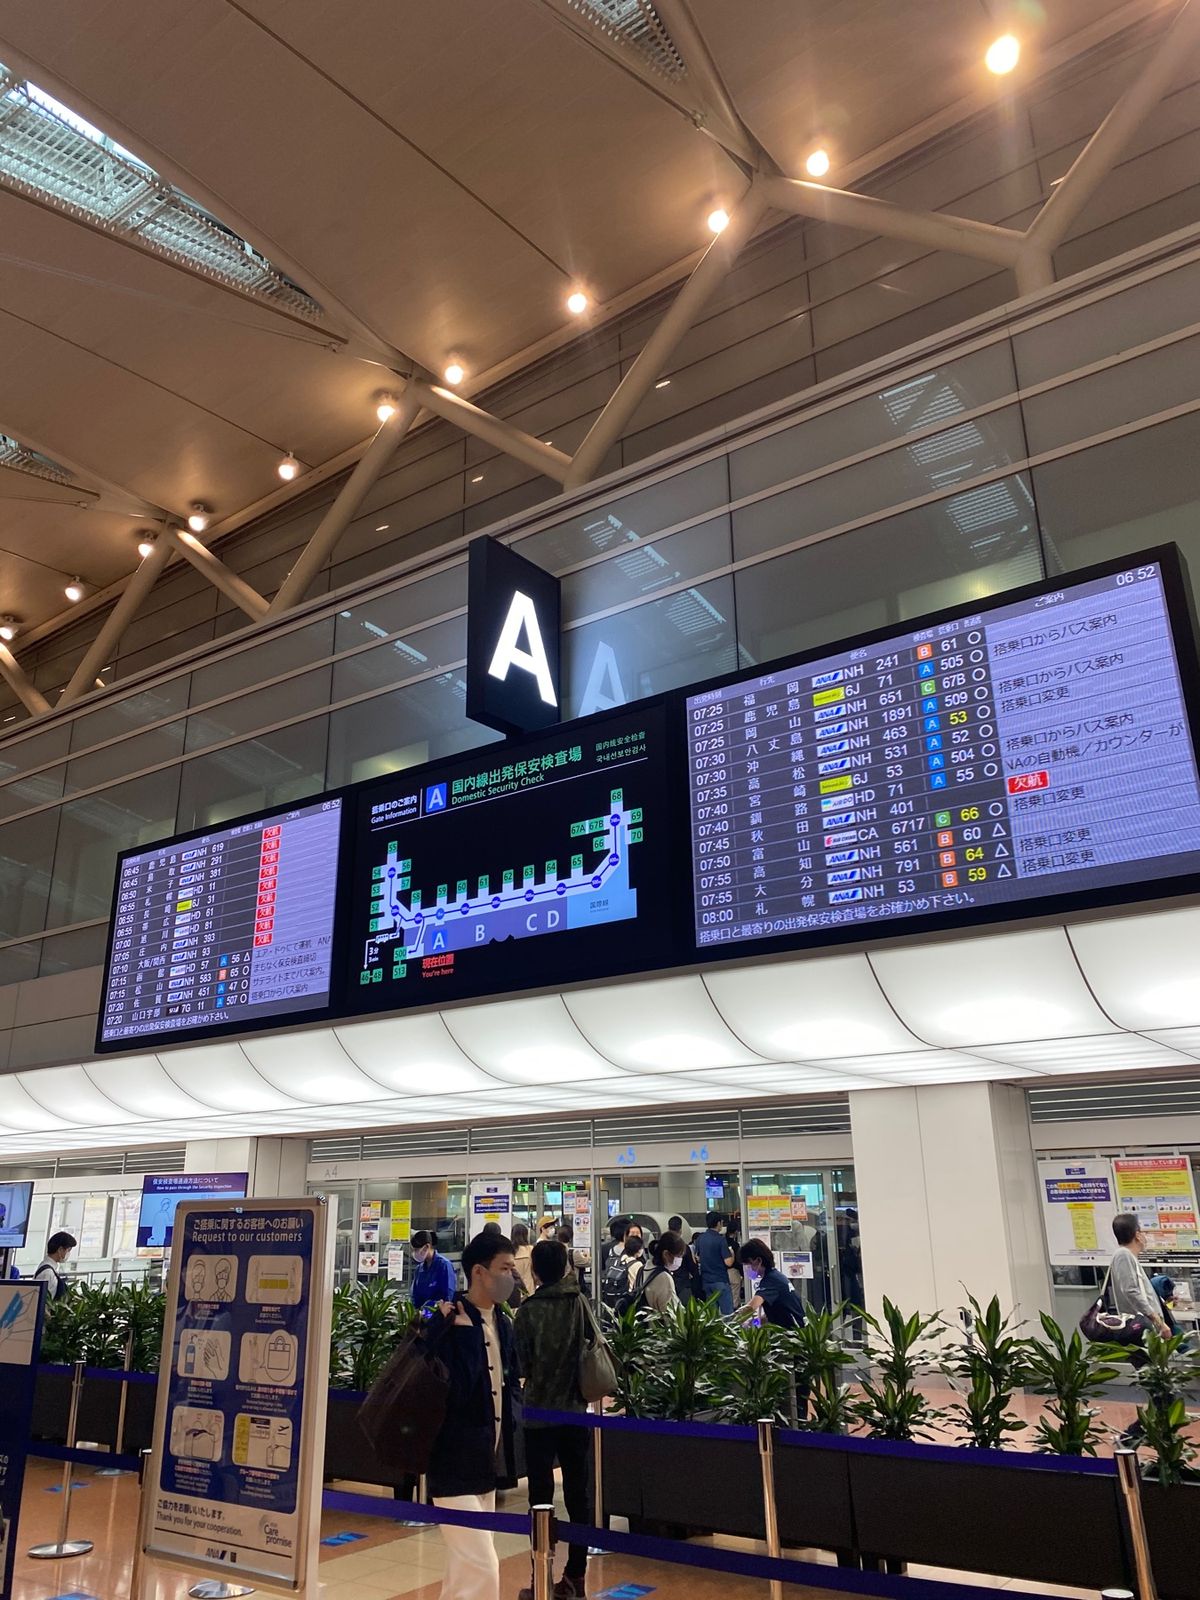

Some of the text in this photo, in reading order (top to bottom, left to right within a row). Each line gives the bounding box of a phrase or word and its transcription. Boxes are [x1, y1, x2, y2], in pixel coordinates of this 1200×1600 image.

[488, 590, 557, 707] A
[694, 719, 723, 737] 07:25
[844, 682, 860, 697] 6J
[877, 673, 892, 688] 71
[939, 653, 963, 670] 505
[992, 611, 1118, 657] 搭乗口からバス案内
[693, 703, 723, 721] 07:25
[843, 663, 863, 679] NH
[875, 653, 899, 670] 241
[939, 636, 958, 652] 61
[694, 736, 724, 754] 07:25
[846, 698, 867, 714] NH
[878, 688, 903, 706] 651
[941, 672, 966, 689] 67B
[695, 752, 725, 770] 07:30
[848, 716, 868, 732] NH
[881, 704, 912, 723] 1891
[943, 690, 968, 707] 509
[997, 650, 1124, 695] 搭乗口からバス案内
[696, 769, 726, 786] 07:30
[849, 734, 870, 750] NH
[882, 724, 907, 742] 463
[948, 710, 967, 725] 53
[1000, 685, 1069, 714] 搭乗口変更
[452, 746, 582, 795] 国内線出発保安検査場
[596, 744, 646, 763] 국내선보안검사
[696, 785, 727, 803] 07:35
[851, 752, 872, 768] NH
[884, 743, 909, 760] 531
[950, 728, 970, 744] 52
[697, 802, 728, 820] 07:40
[852, 771, 868, 786] 6J
[885, 763, 903, 778] 53
[950, 747, 975, 764] 504
[1005, 711, 1135, 752] 搭乗口からバス案内
[428, 788, 443, 809] A
[452, 773, 545, 805] Domestic Security Check
[698, 819, 728, 837] 07:40
[854, 788, 875, 804] HD
[887, 782, 904, 797] 71
[955, 767, 974, 782] 55
[371, 807, 417, 824] Gate Information
[698, 837, 729, 854] 07:45
[856, 807, 877, 823] NH
[889, 799, 915, 816] 401
[699, 854, 730, 871] 07:50
[857, 826, 879, 842] CA
[891, 817, 925, 835] 6717
[960, 806, 979, 822] 66
[1013, 786, 1085, 812] 搭乗口変更
[700, 872, 731, 888] 07:55
[859, 845, 880, 860] NH
[893, 838, 919, 854] 561
[962, 826, 982, 842] 60
[700, 890, 732, 906] 07:55
[860, 864, 882, 880] NH
[895, 858, 921, 874] 791
[964, 847, 984, 862] 64
[1019, 828, 1092, 853] 搭乗口変更
[701, 908, 733, 924] 08:00
[862, 884, 884, 899] NH
[897, 879, 915, 894] 53
[967, 867, 987, 882] 59
[1022, 849, 1095, 874] 搭乗口変更
[433, 932, 445, 950] A
[475, 924, 485, 941] B
[526, 913, 538, 931] C
[547, 910, 559, 928] D
[192, 1231, 303, 1244] Request to our customers
[193, 1217, 304, 1231] ご搭乗に関するお客様へのお願い
[156, 1510, 173, 1522] Thank
[173, 1516, 184, 1525] you
[184, 1516, 193, 1526] for
[193, 1520, 209, 1530] your
[264, 1524, 279, 1536] Care
[265, 1535, 292, 1548] promise
